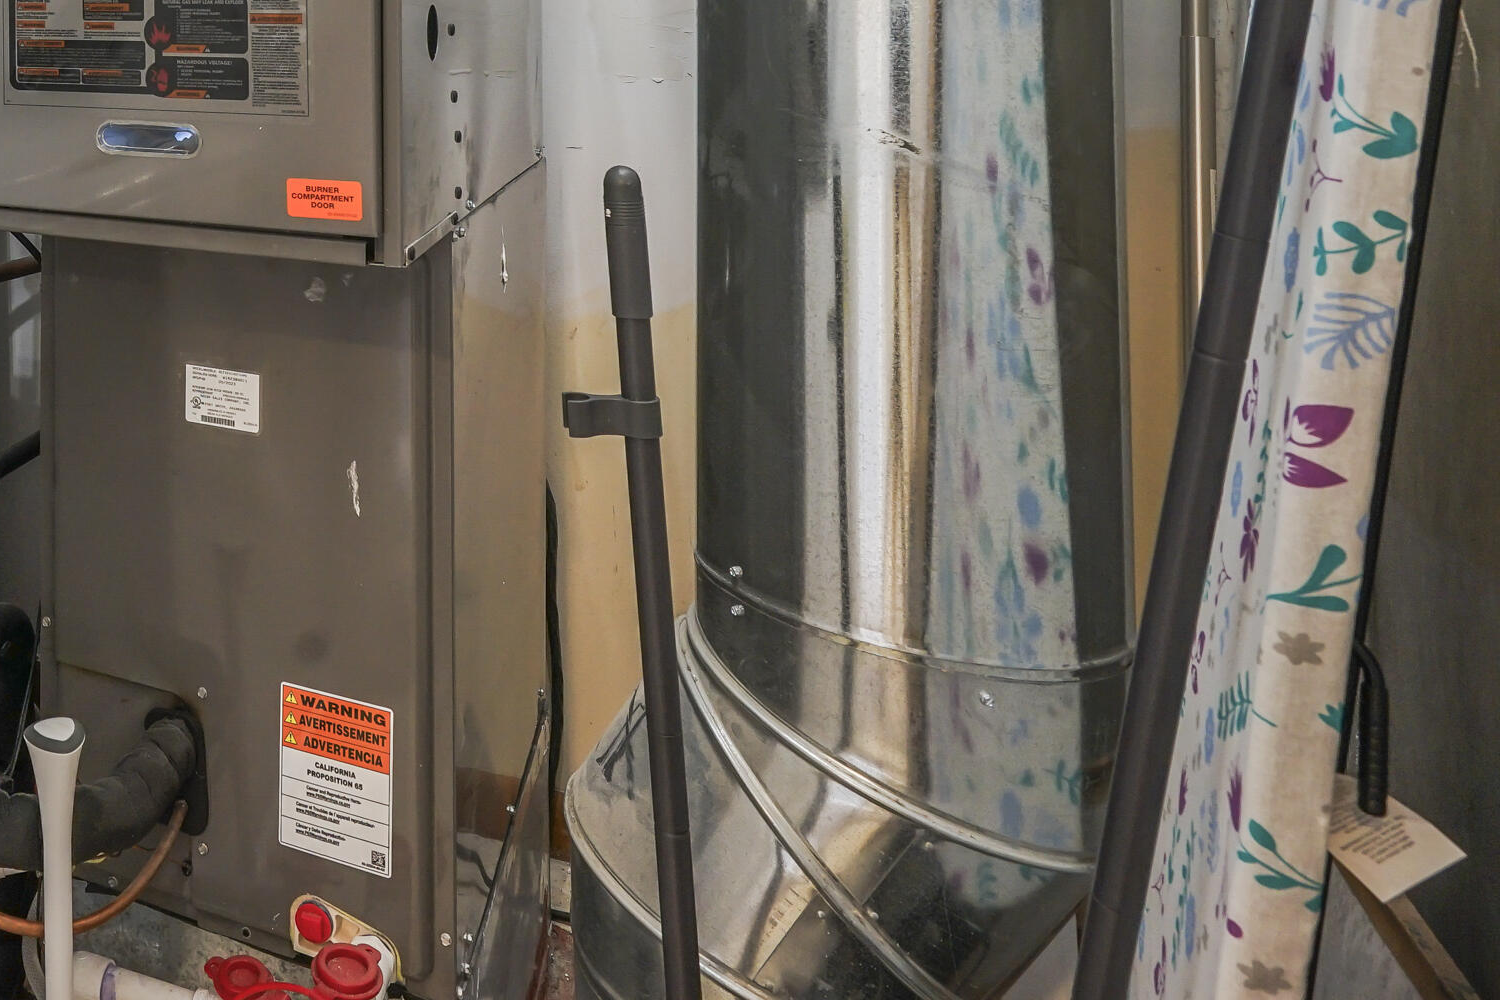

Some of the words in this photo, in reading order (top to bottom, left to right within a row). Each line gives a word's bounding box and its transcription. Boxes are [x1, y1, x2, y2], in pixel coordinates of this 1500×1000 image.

[291, 193, 354, 202] COMPARTMENT
[305, 185, 339, 194] BURNER
[300, 694, 387, 727] WARNING
[299, 714, 387, 747] AVERTISSEMENT
[303, 735, 383, 768] ADVERTENCIA
[307, 769, 353, 788] PROPOSITION
[355, 783, 363, 791] 65
[315, 762, 356, 779] CALIFORNIA
